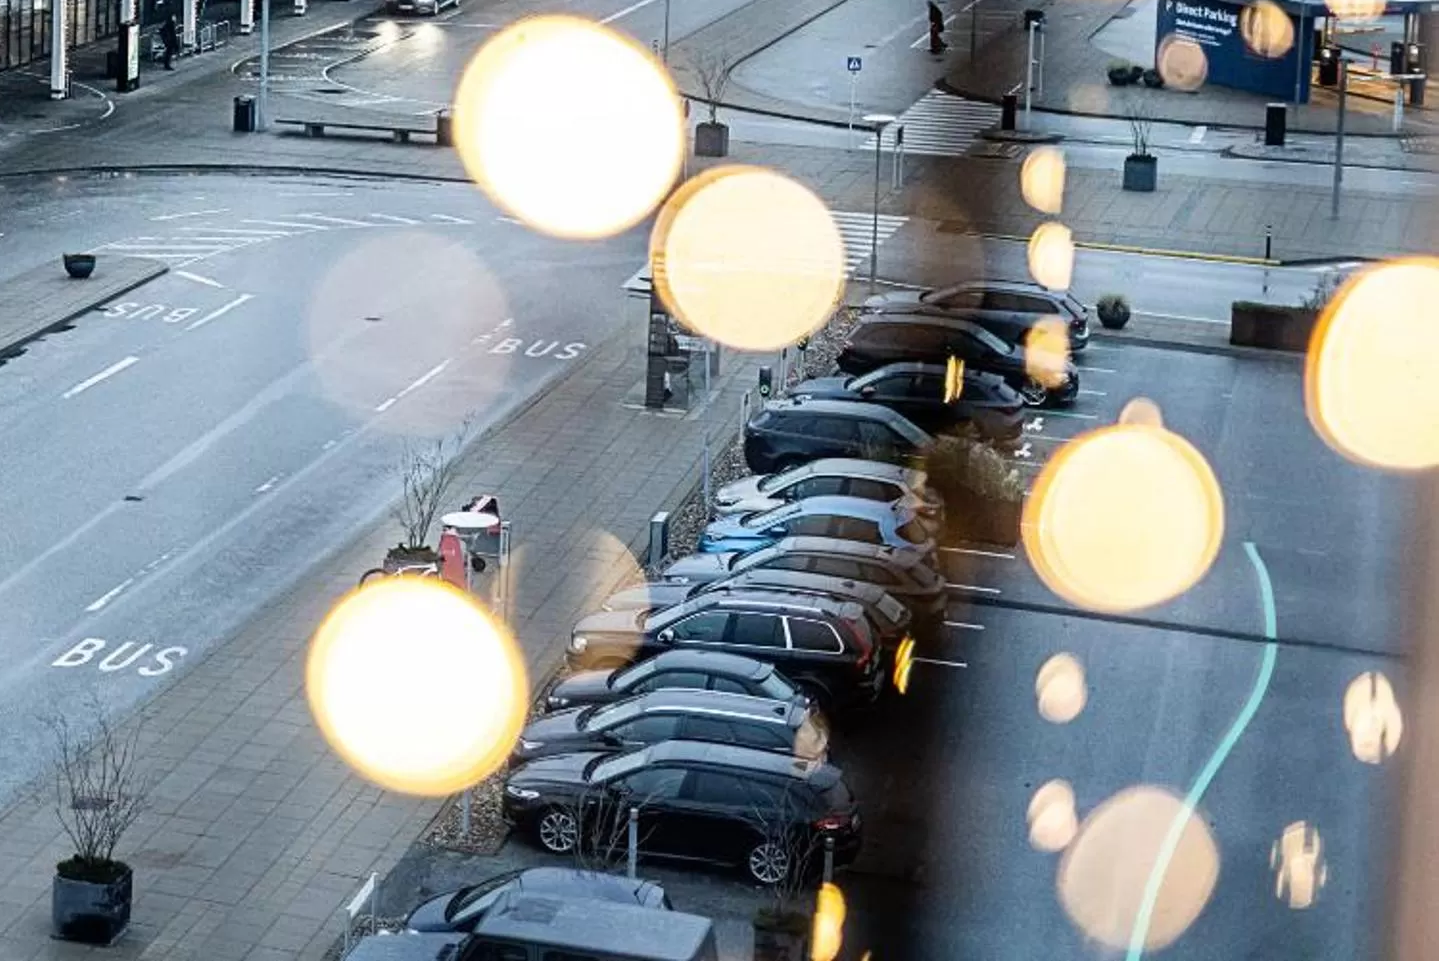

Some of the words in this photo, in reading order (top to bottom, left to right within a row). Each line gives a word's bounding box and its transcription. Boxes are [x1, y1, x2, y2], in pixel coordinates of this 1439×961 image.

[1176, 2, 1202, 17] Direct
[1204, 6, 1237, 27] Parking
[103, 303, 199, 323] BUS
[487, 338, 587, 359] BUS
[51, 638, 188, 676] BUS
